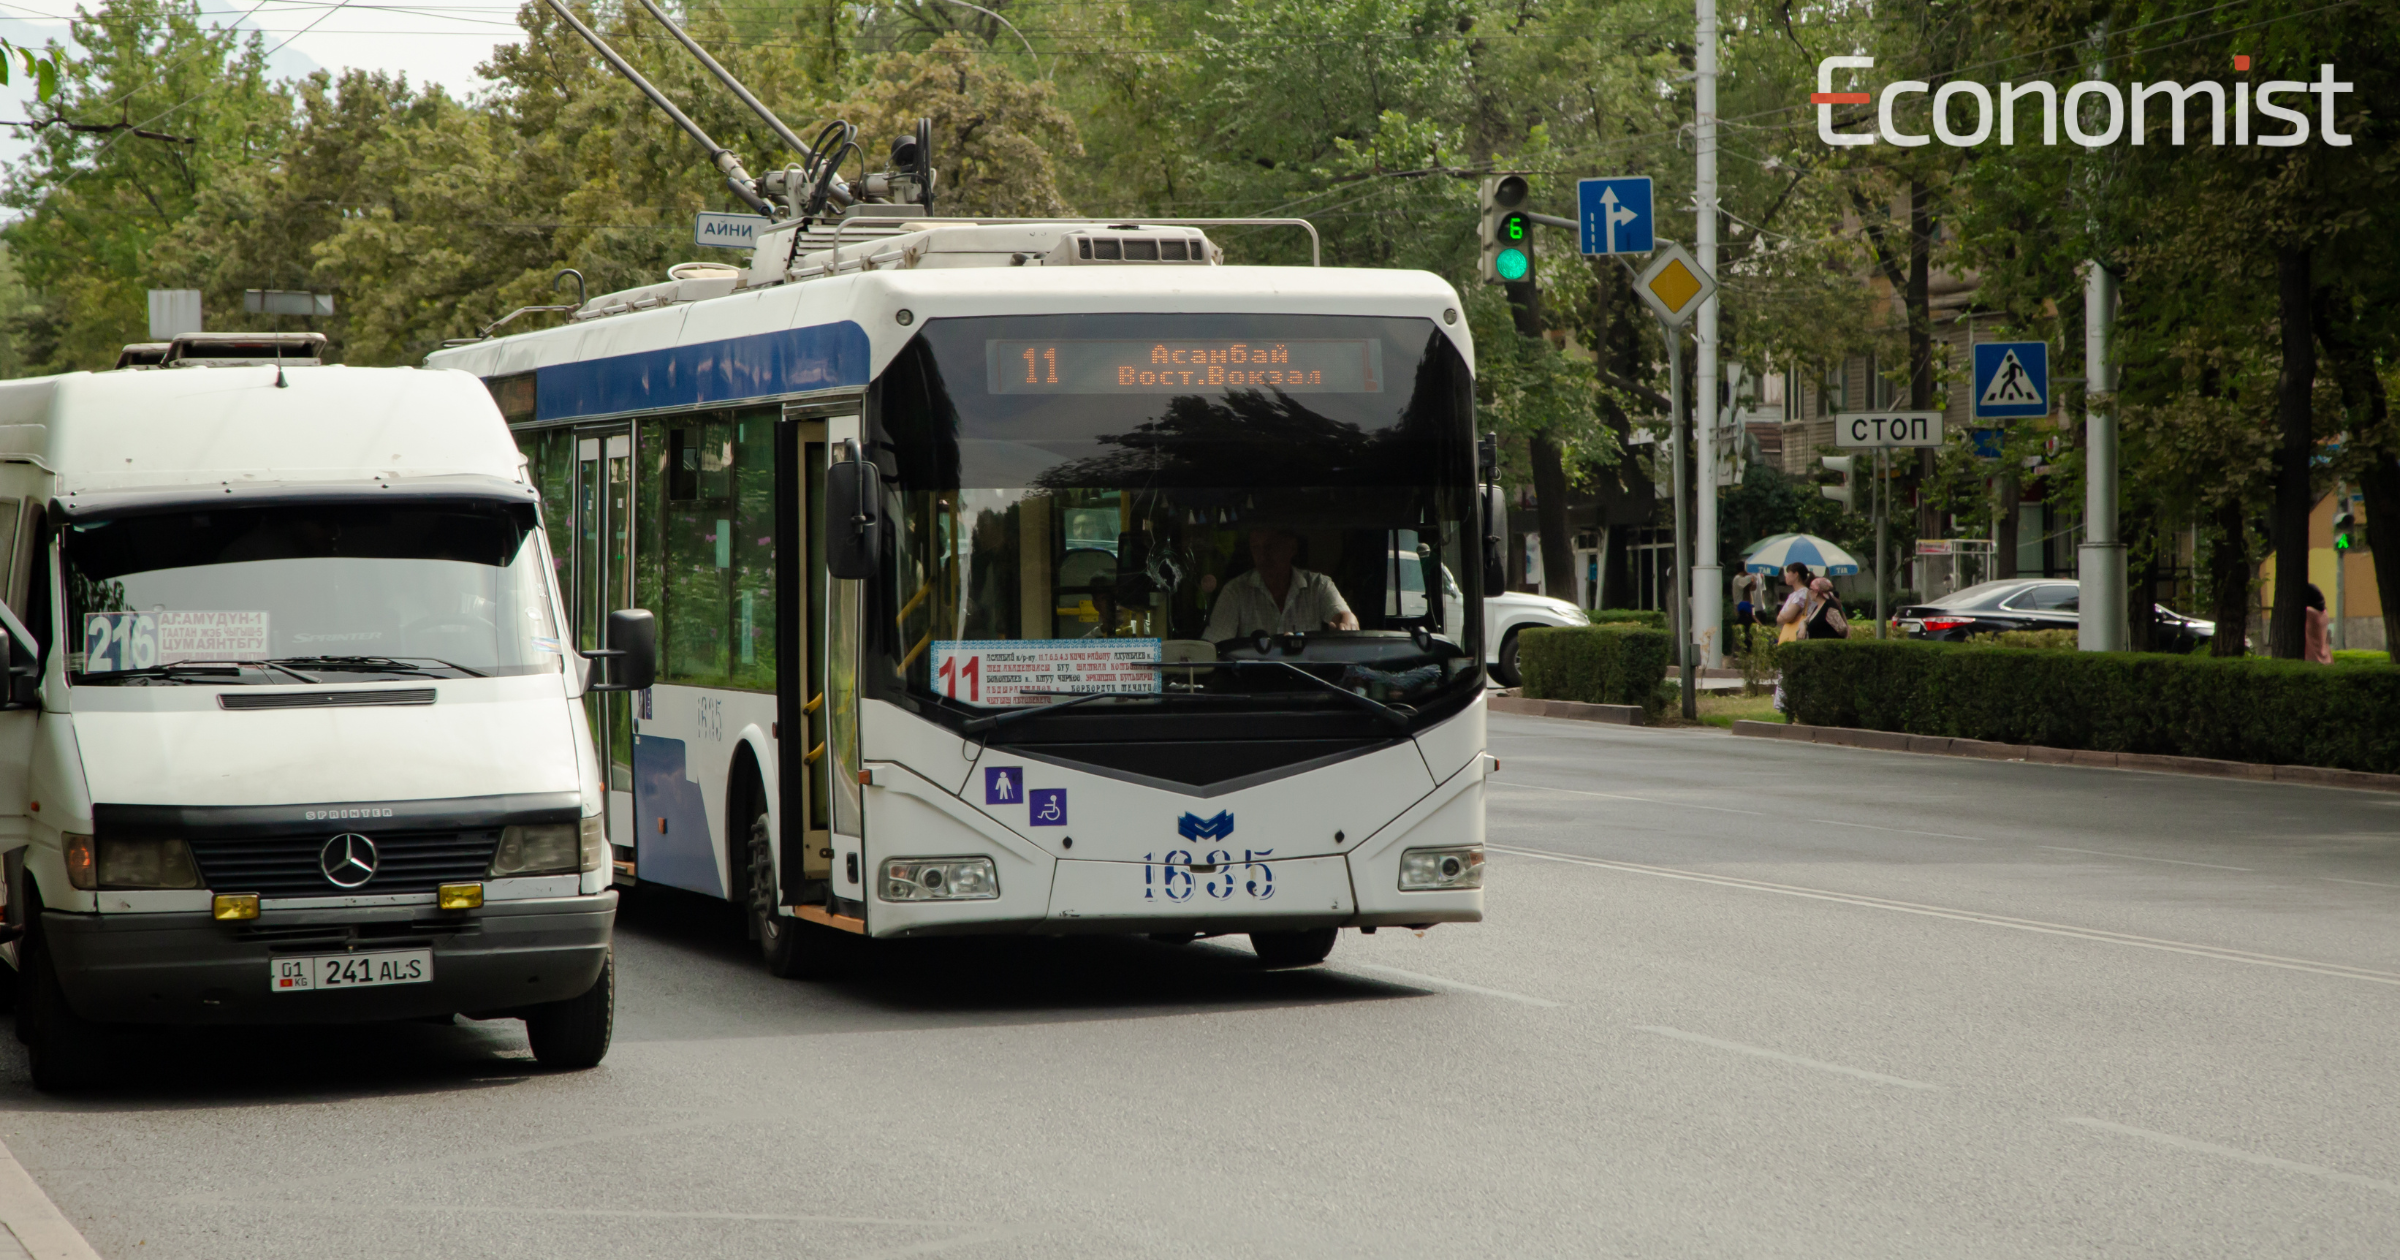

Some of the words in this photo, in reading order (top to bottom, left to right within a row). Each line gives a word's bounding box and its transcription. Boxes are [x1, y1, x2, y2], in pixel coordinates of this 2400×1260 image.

[704, 219, 752, 238] АЙНИ
[1509, 217, 1524, 240] 6
[1023, 347, 1059, 384] 11
[1151, 343, 1289, 365] Асанбай
[1118, 365, 1322, 386] Вост.Вокзал
[1851, 418, 1928, 442] СТОП
[87, 615, 157, 672] 216
[161, 627, 197, 638] ТААТАН
[200, 628, 221, 638] ЖЭБ
[938, 655, 980, 702] 11
[305, 808, 393, 821] SPRINTER
[1143, 848, 1276, 903] 1635
[282, 961, 303, 978] 01
[326, 958, 374, 985] 241
[380, 959, 422, 981] ALS
[294, 978, 308, 987] KG
